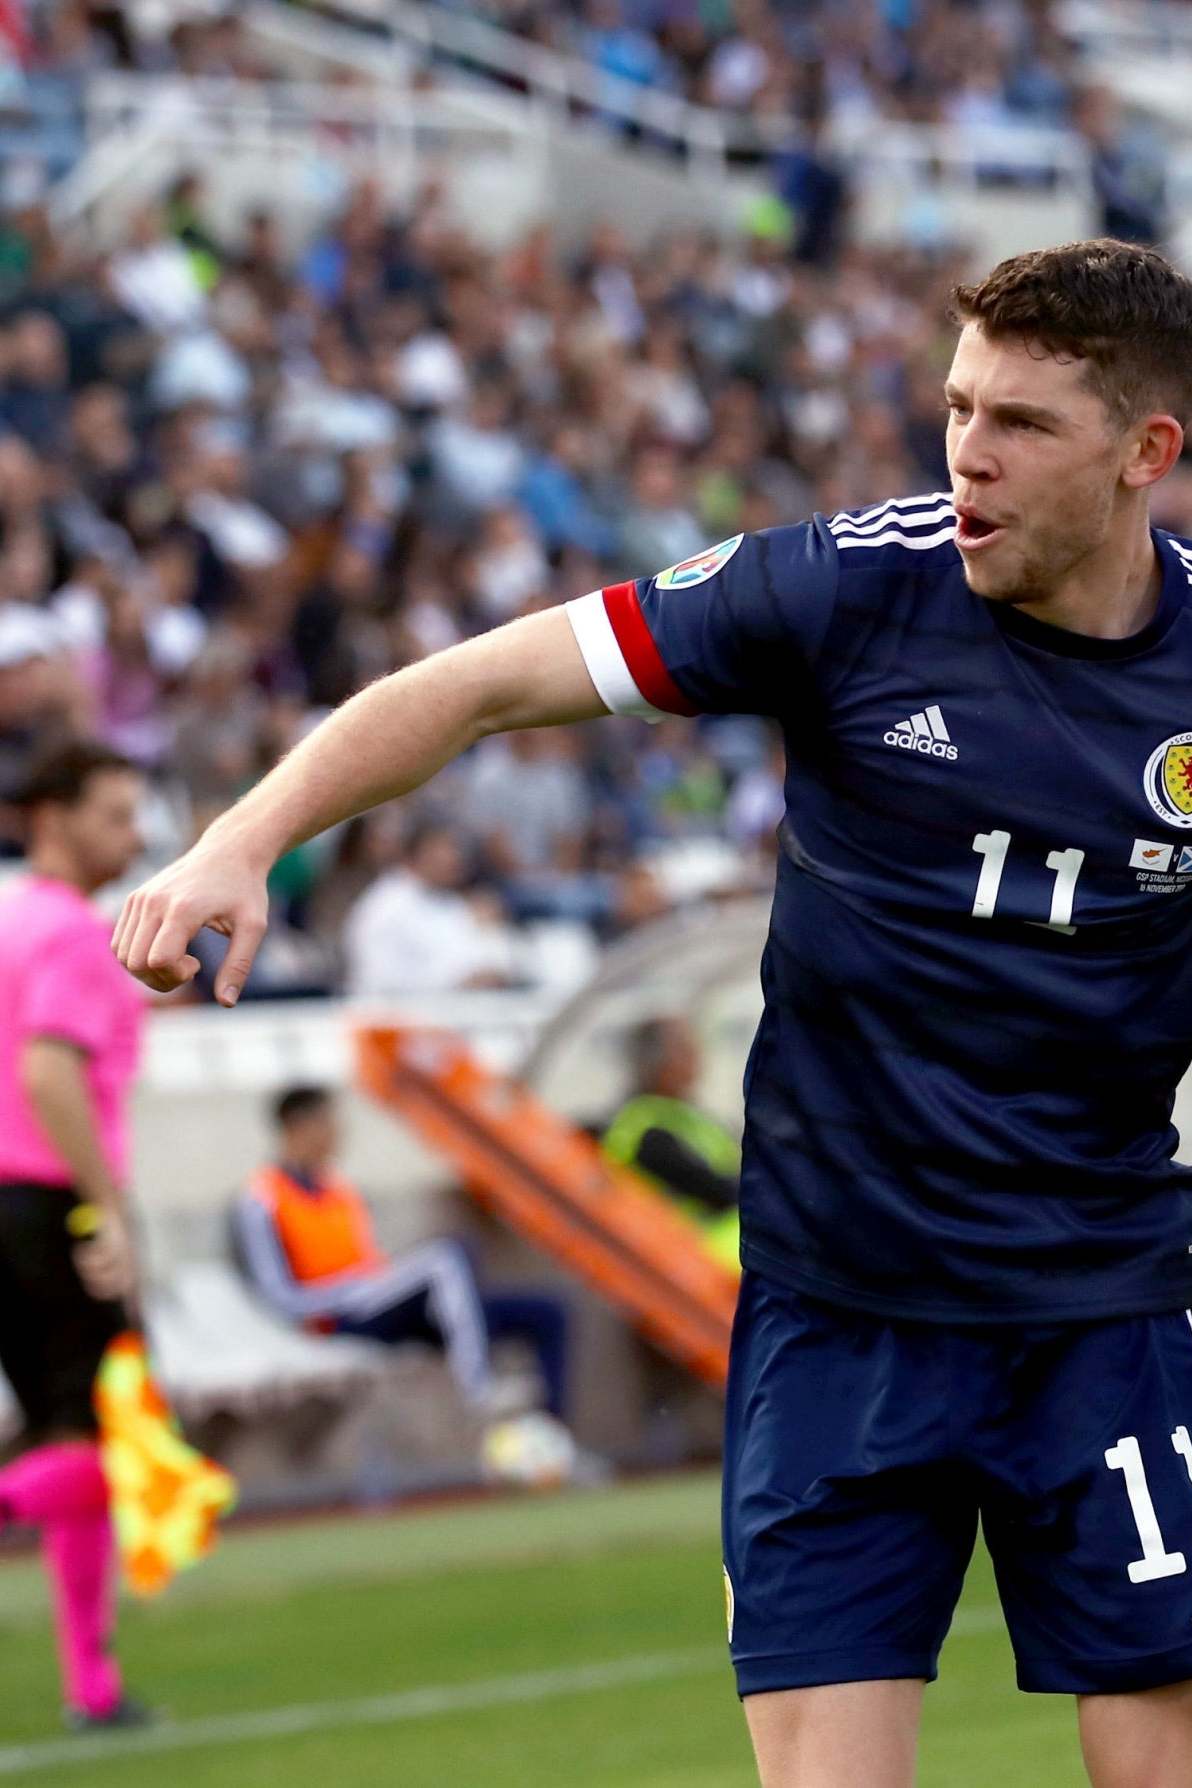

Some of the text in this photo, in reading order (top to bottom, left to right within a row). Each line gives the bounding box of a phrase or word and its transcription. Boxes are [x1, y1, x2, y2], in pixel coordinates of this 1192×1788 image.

[883, 731, 959, 761] adidas
[972, 829, 1085, 936] 11
[1145, 884, 1176, 894] NOVEMBER
